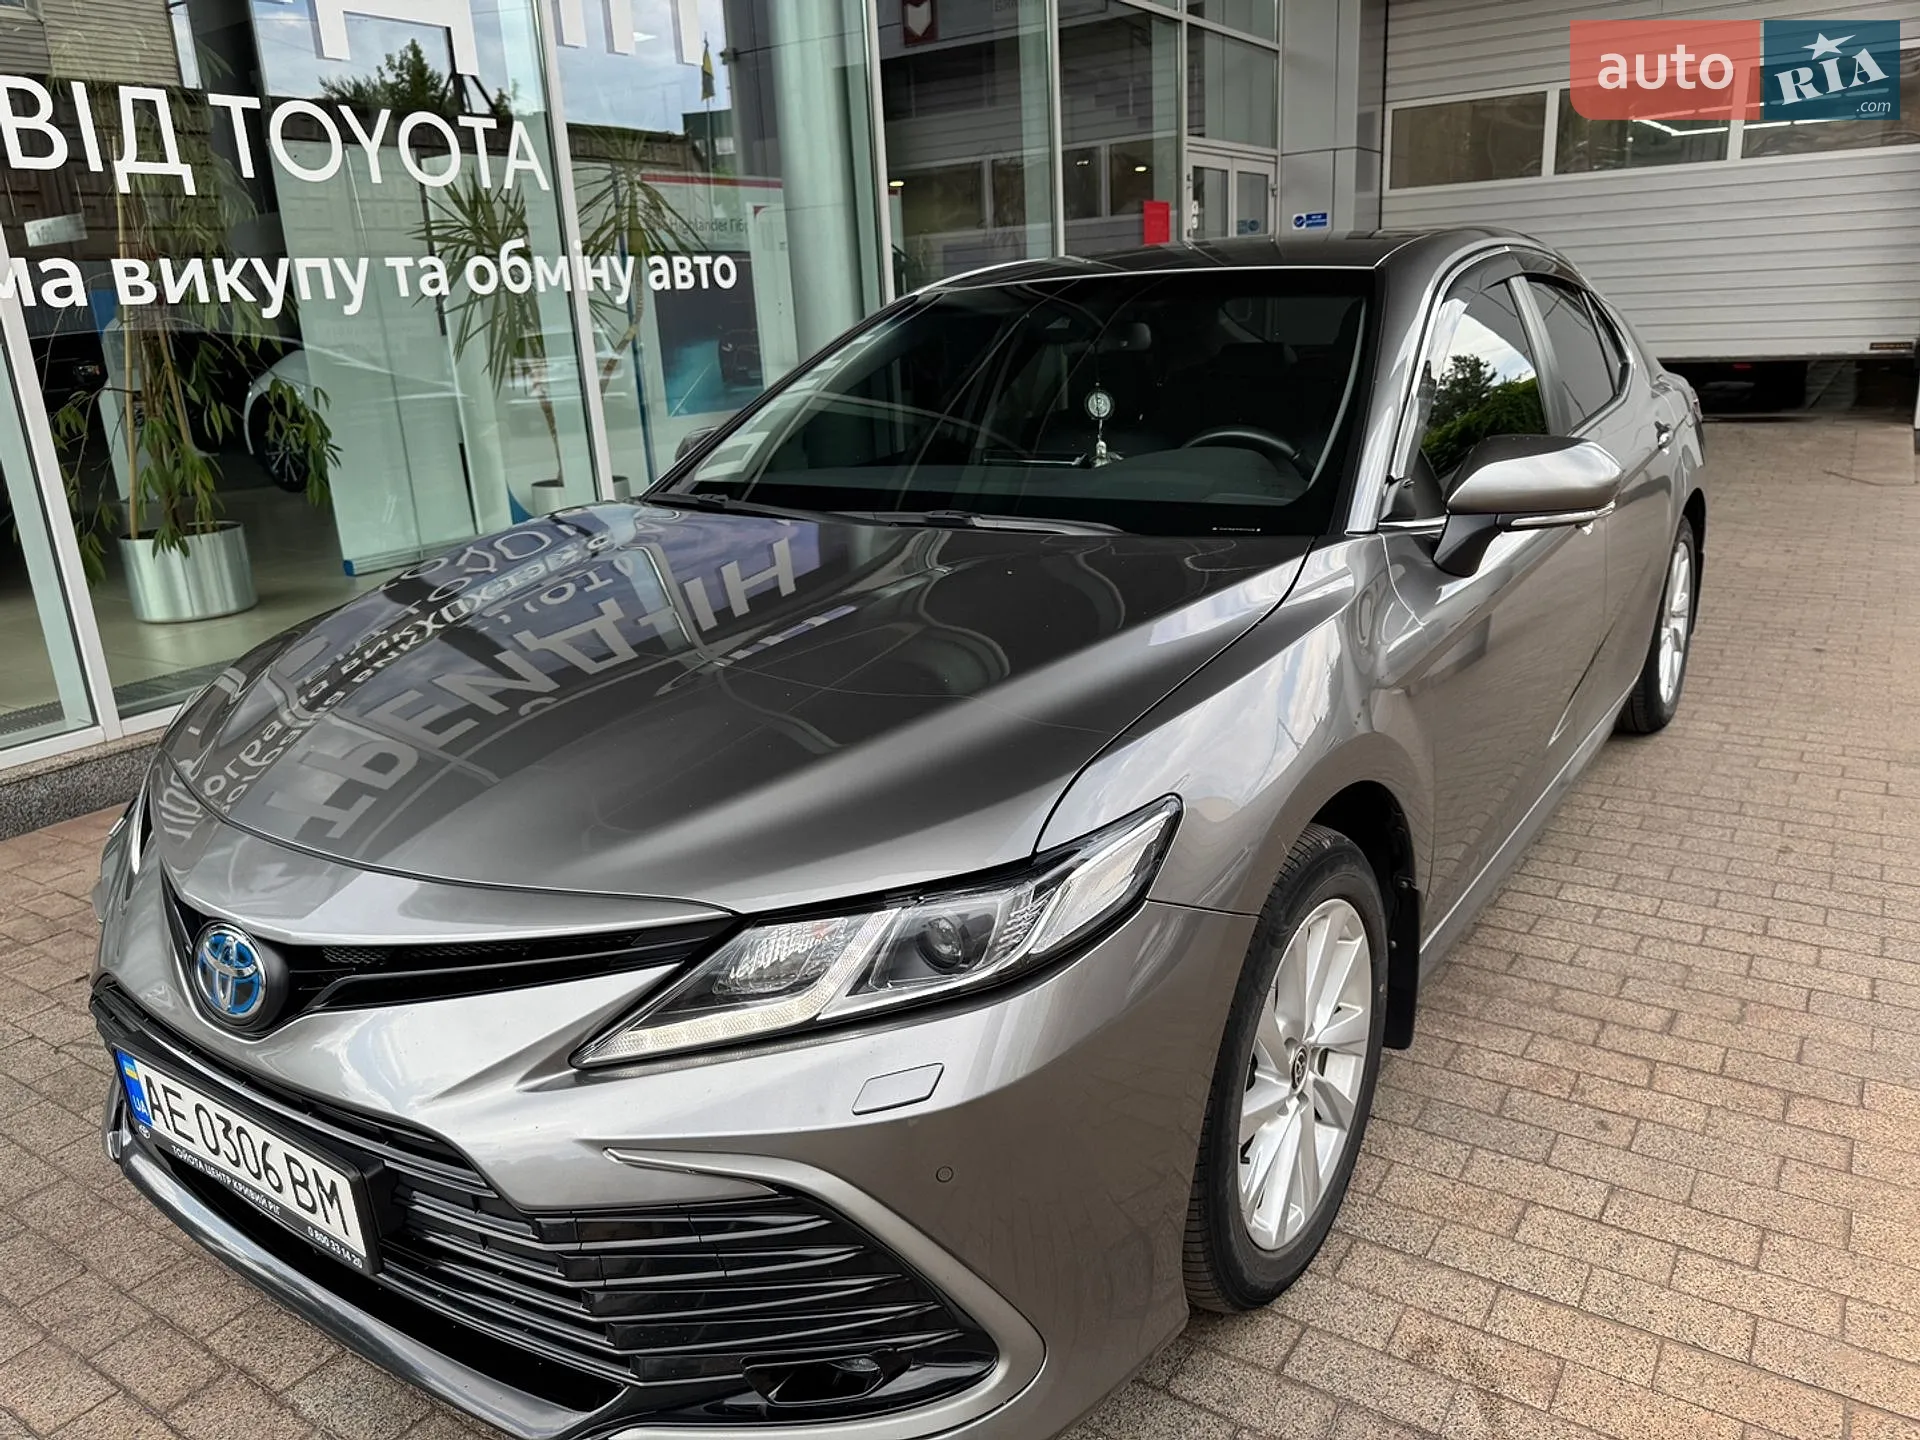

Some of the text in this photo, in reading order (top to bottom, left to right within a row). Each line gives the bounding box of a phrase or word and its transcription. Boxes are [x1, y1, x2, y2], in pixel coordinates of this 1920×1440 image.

[0, 74, 551, 196] ВІД TOYOTA
[111, 256, 368, 318] викупу
[384, 256, 450, 297] та
[465, 238, 634, 305] обміну
[647, 254, 738, 290] авто
[132, 1094, 150, 1117] UA
[144, 1074, 351, 1237] AE 0306 BM
